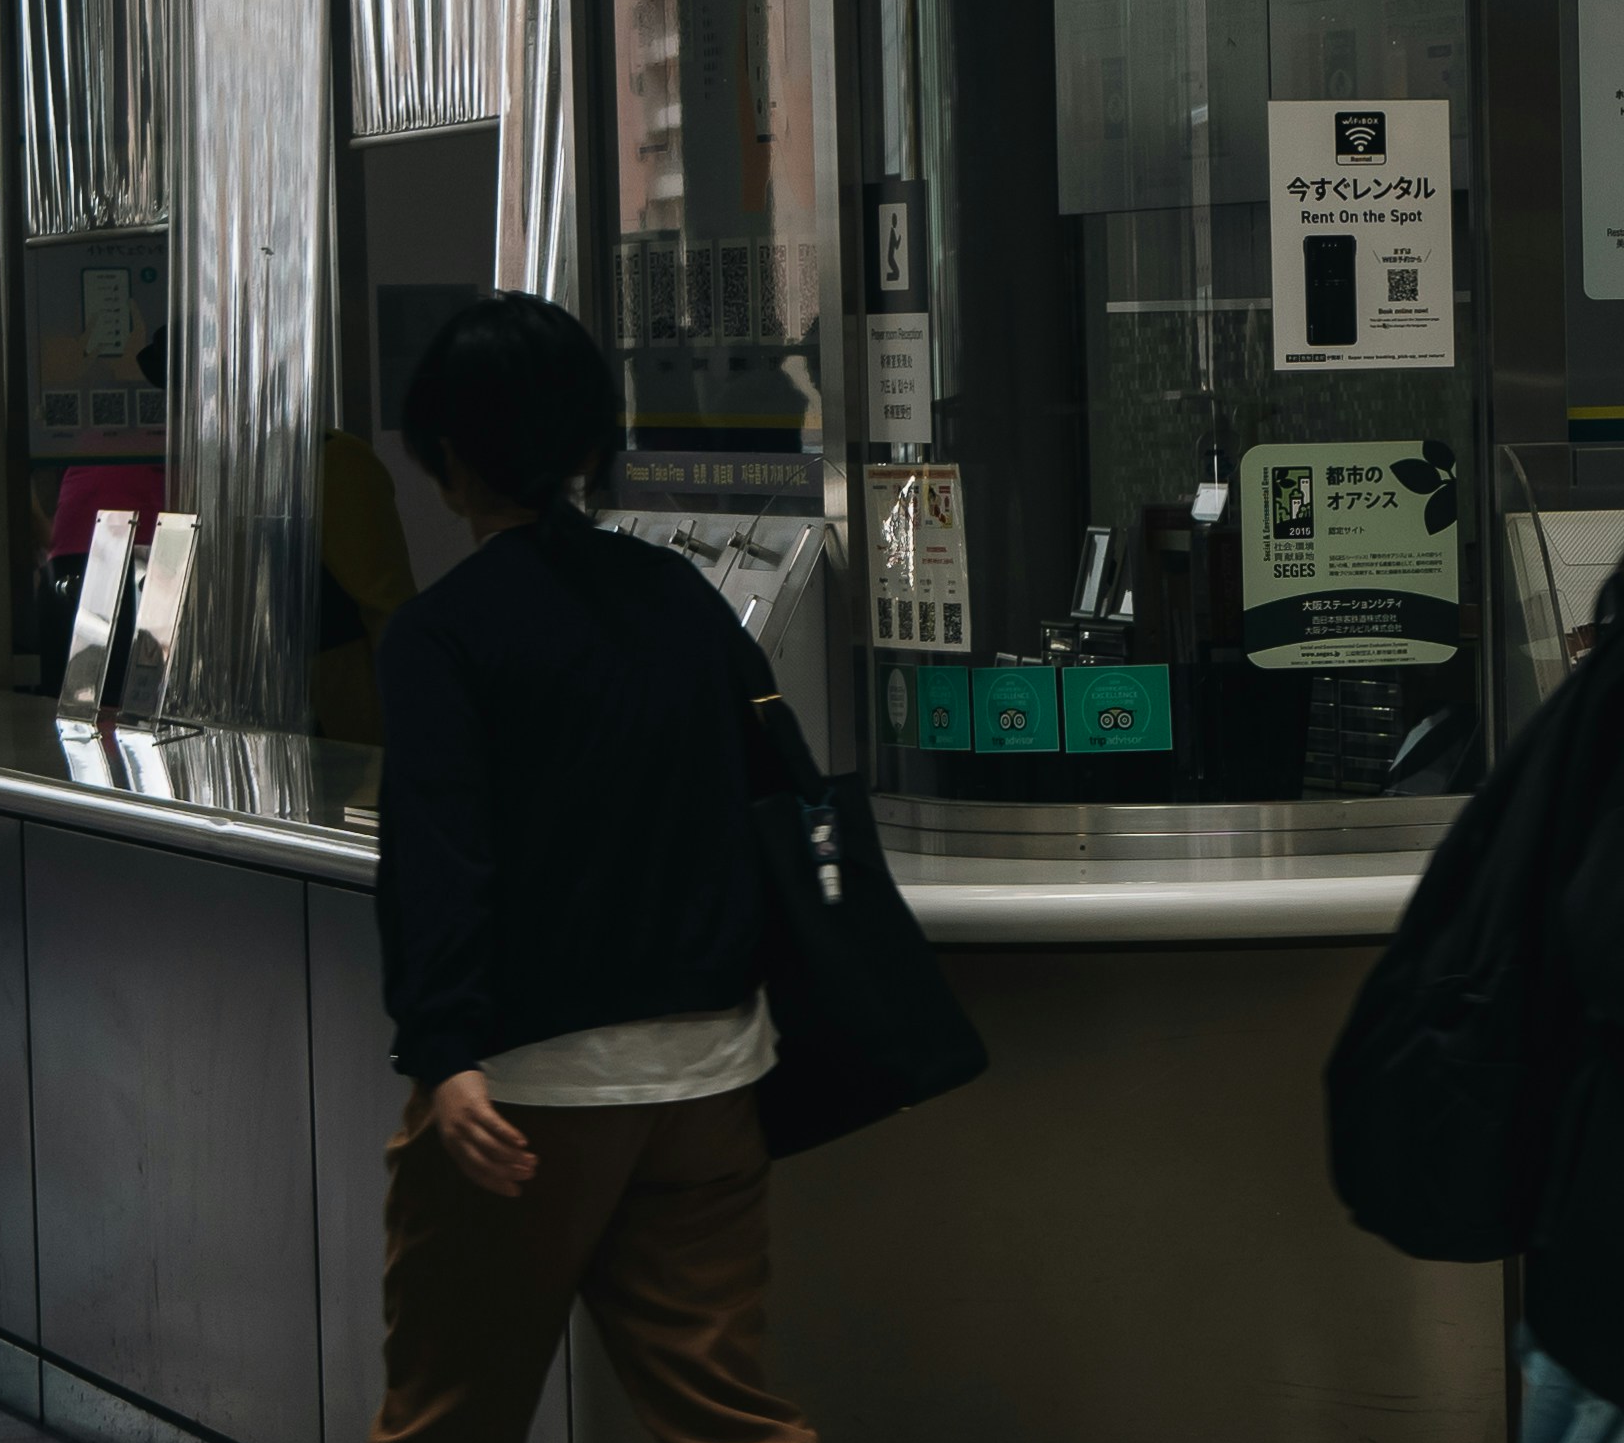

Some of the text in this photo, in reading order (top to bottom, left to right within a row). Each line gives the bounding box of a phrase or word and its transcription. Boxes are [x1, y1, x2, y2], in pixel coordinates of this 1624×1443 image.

[1286, 176, 1436, 202] 今すぐレンタル
[1301, 209, 1422, 225] Rent On the Spot
[1326, 466, 1383, 486] 都市の
[1327, 491, 1399, 510] オアシス
[1262, 487, 1271, 533] Environmental
[1328, 527, 1365, 535] 認定サイト
[1263, 542, 1271, 562] Social
[1273, 563, 1315, 578] SEGES
[1302, 599, 1403, 611] 大阪ステーションシティ
[1305, 624, 1403, 635] 大阪ターミナルビル株式会社
[992, 736, 1034, 747] tripadvisor
[1089, 735, 1143, 746] tripadvisor
